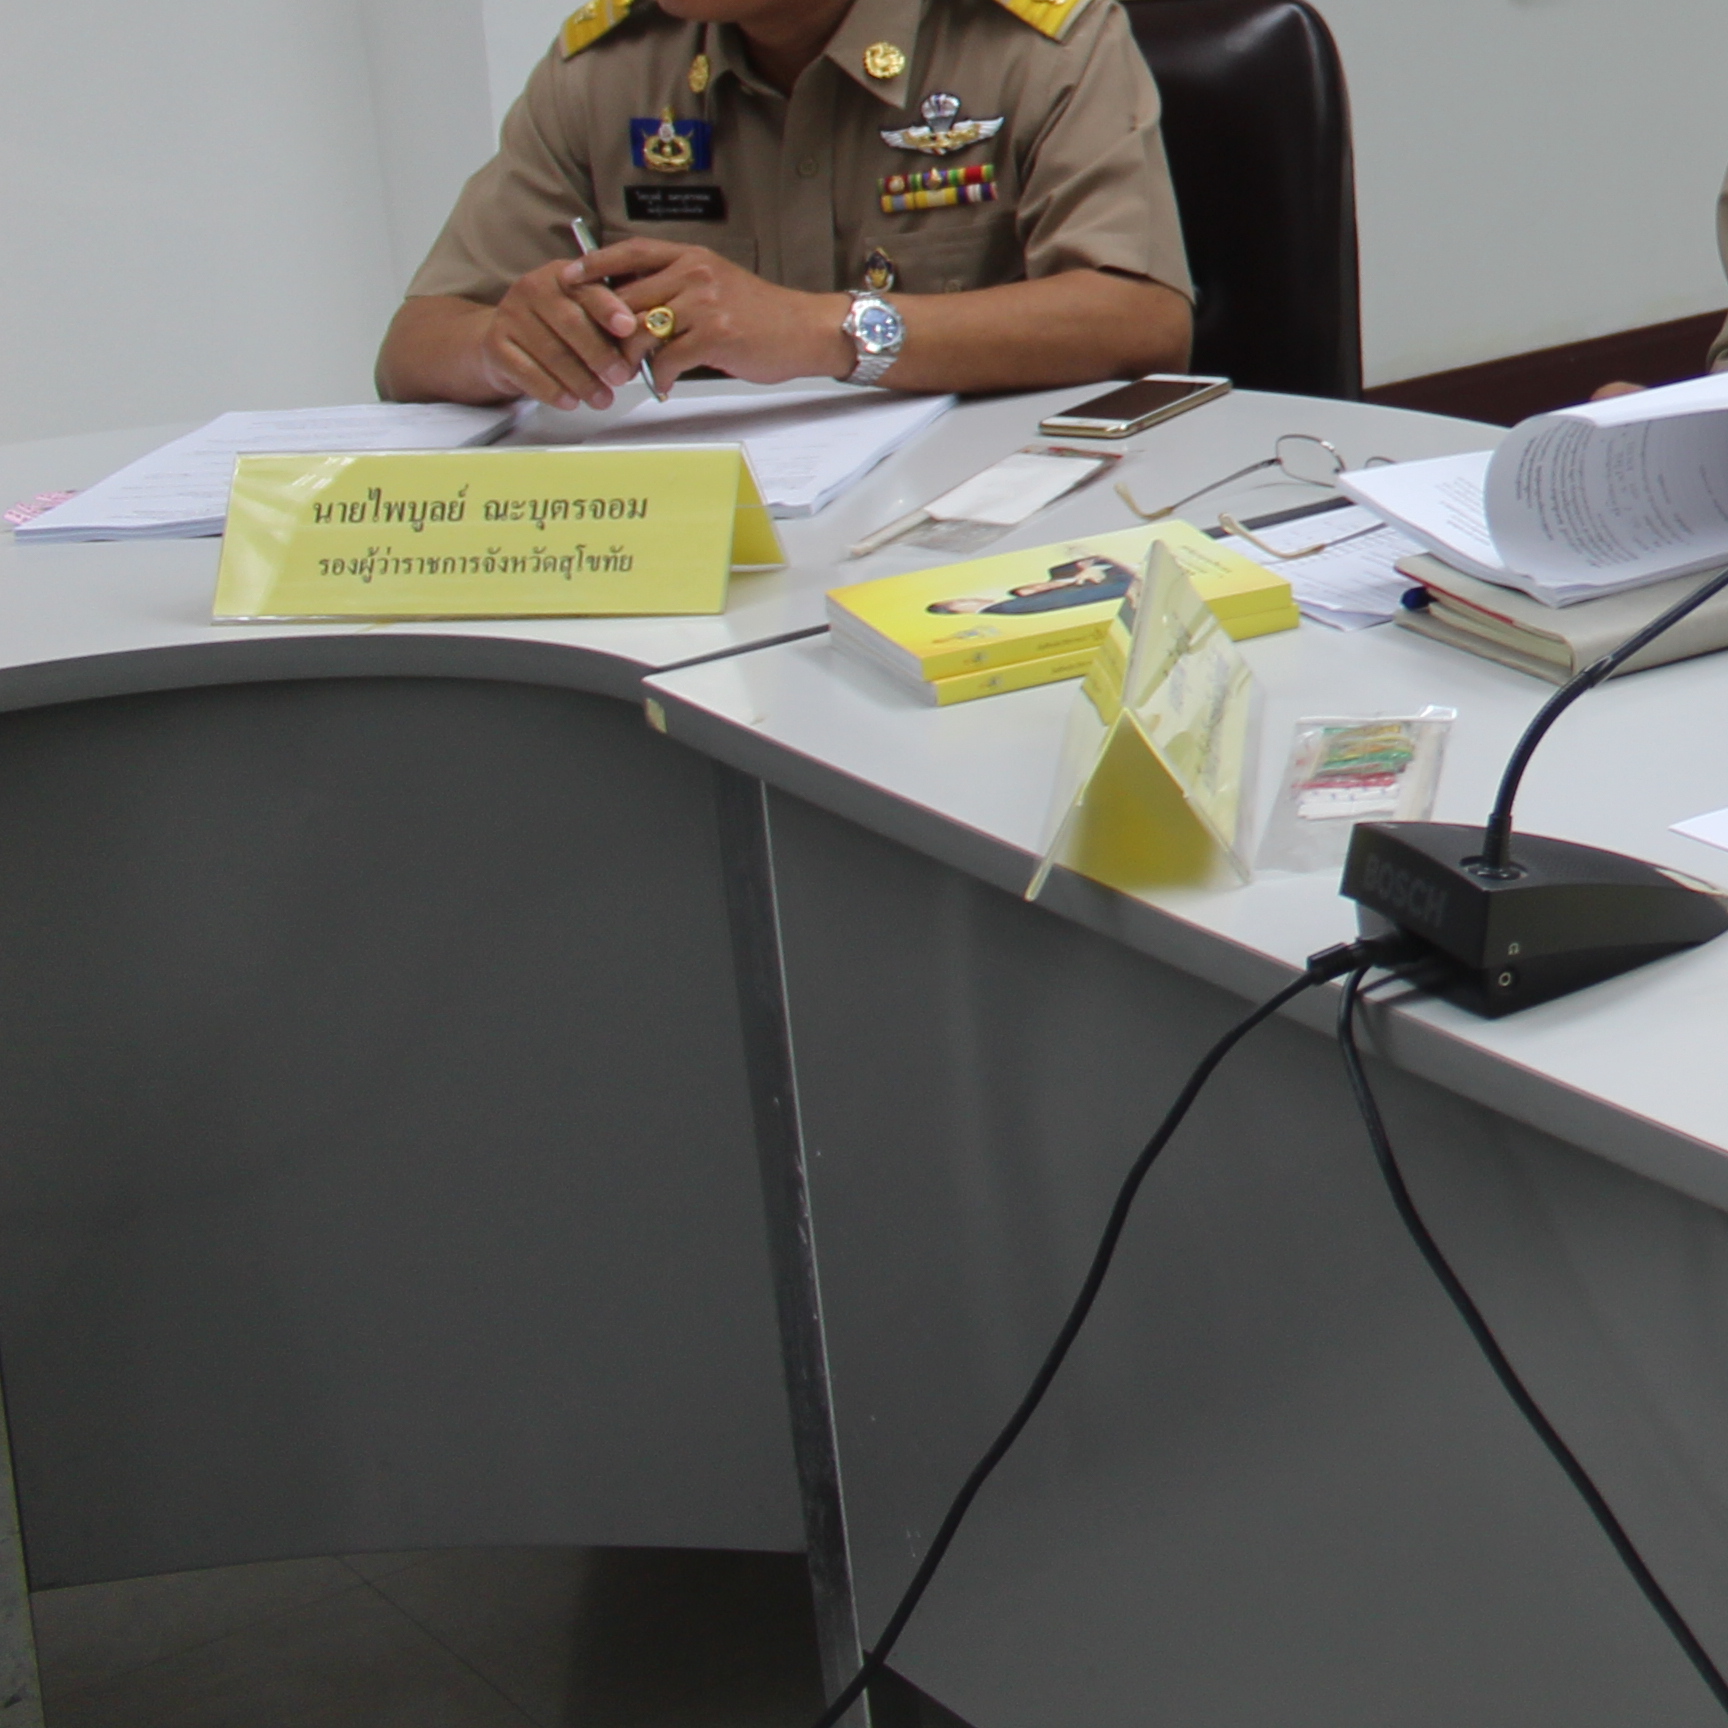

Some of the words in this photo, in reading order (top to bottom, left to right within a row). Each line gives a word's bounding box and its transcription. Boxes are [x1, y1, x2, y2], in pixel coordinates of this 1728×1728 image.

[313, 484, 469, 532] นายไพบูลย์
[483, 495, 648, 530] ณะบุตรจอม
[318, 544, 634, 583] รองผู้ว่าราชการจังหวัดสุโขทัย
[1363, 853, 1447, 928] BOSCH
